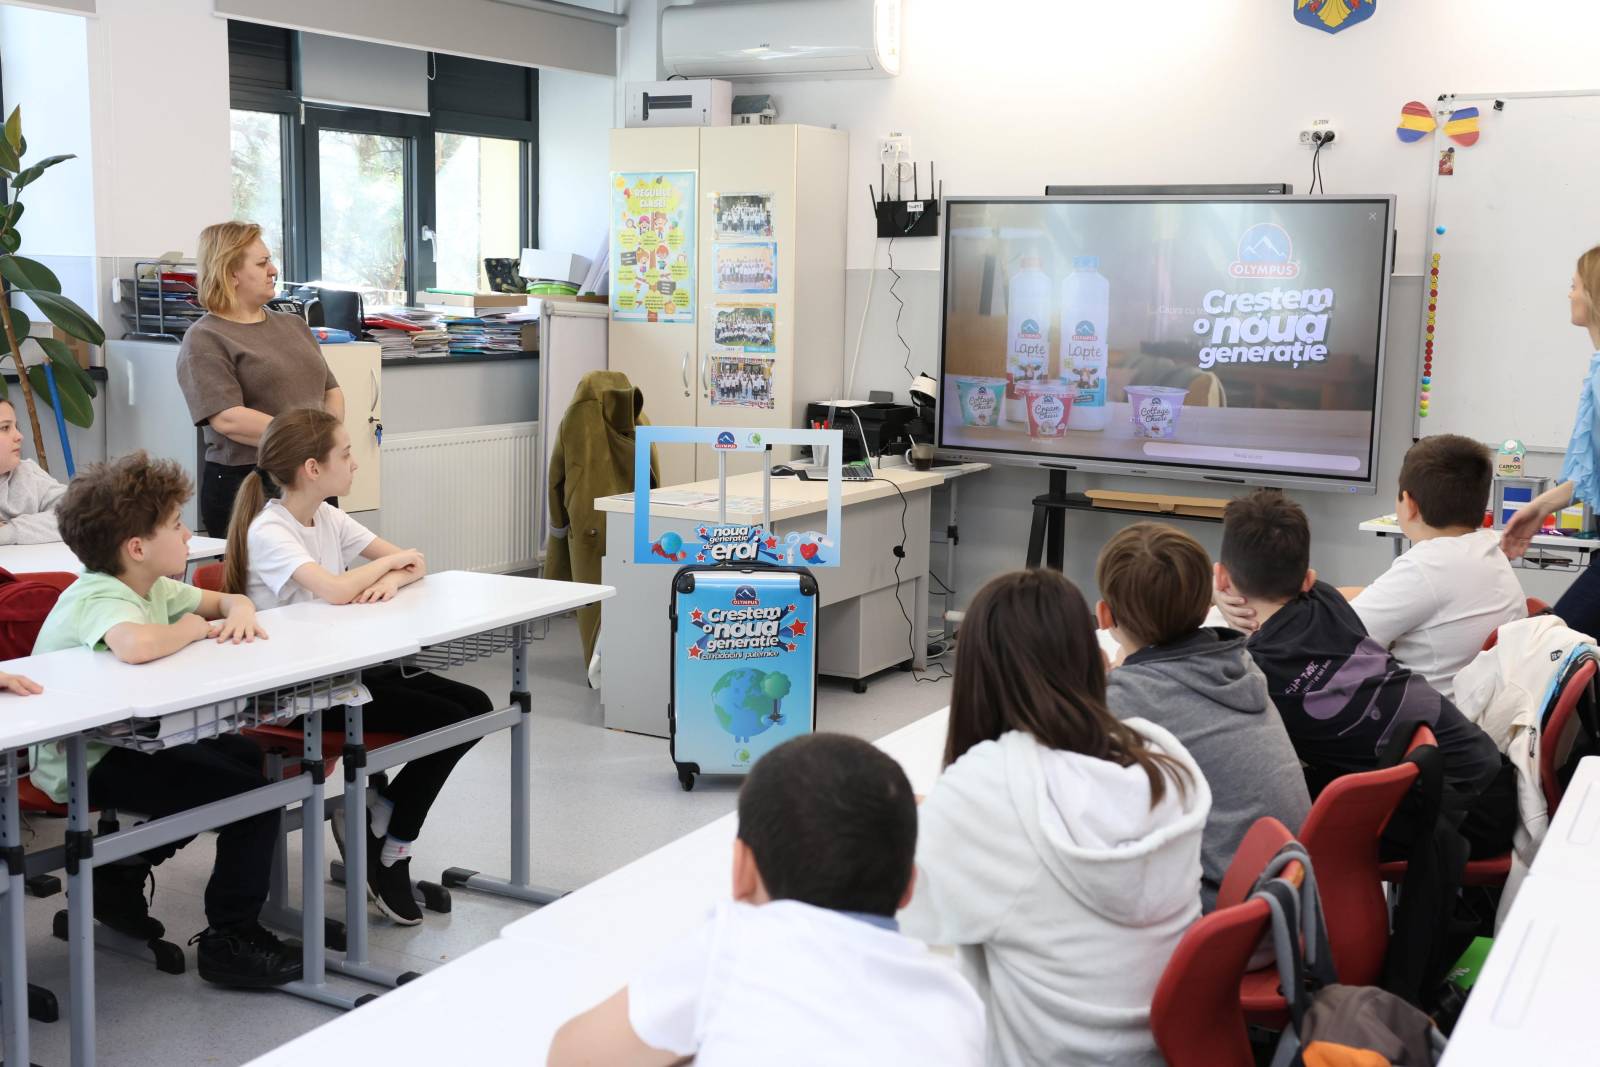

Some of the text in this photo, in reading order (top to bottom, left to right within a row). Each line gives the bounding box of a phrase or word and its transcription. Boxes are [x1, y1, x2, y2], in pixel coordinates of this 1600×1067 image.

[1234, 263, 1294, 276] OLYMPUS
[1192, 318, 1210, 334] o
[1014, 340, 1046, 358] Lapte
[1068, 343, 1103, 361] Lapte
[713, 527, 749, 537] noua
[711, 535, 759, 561] eroi
[702, 624, 712, 634] o
